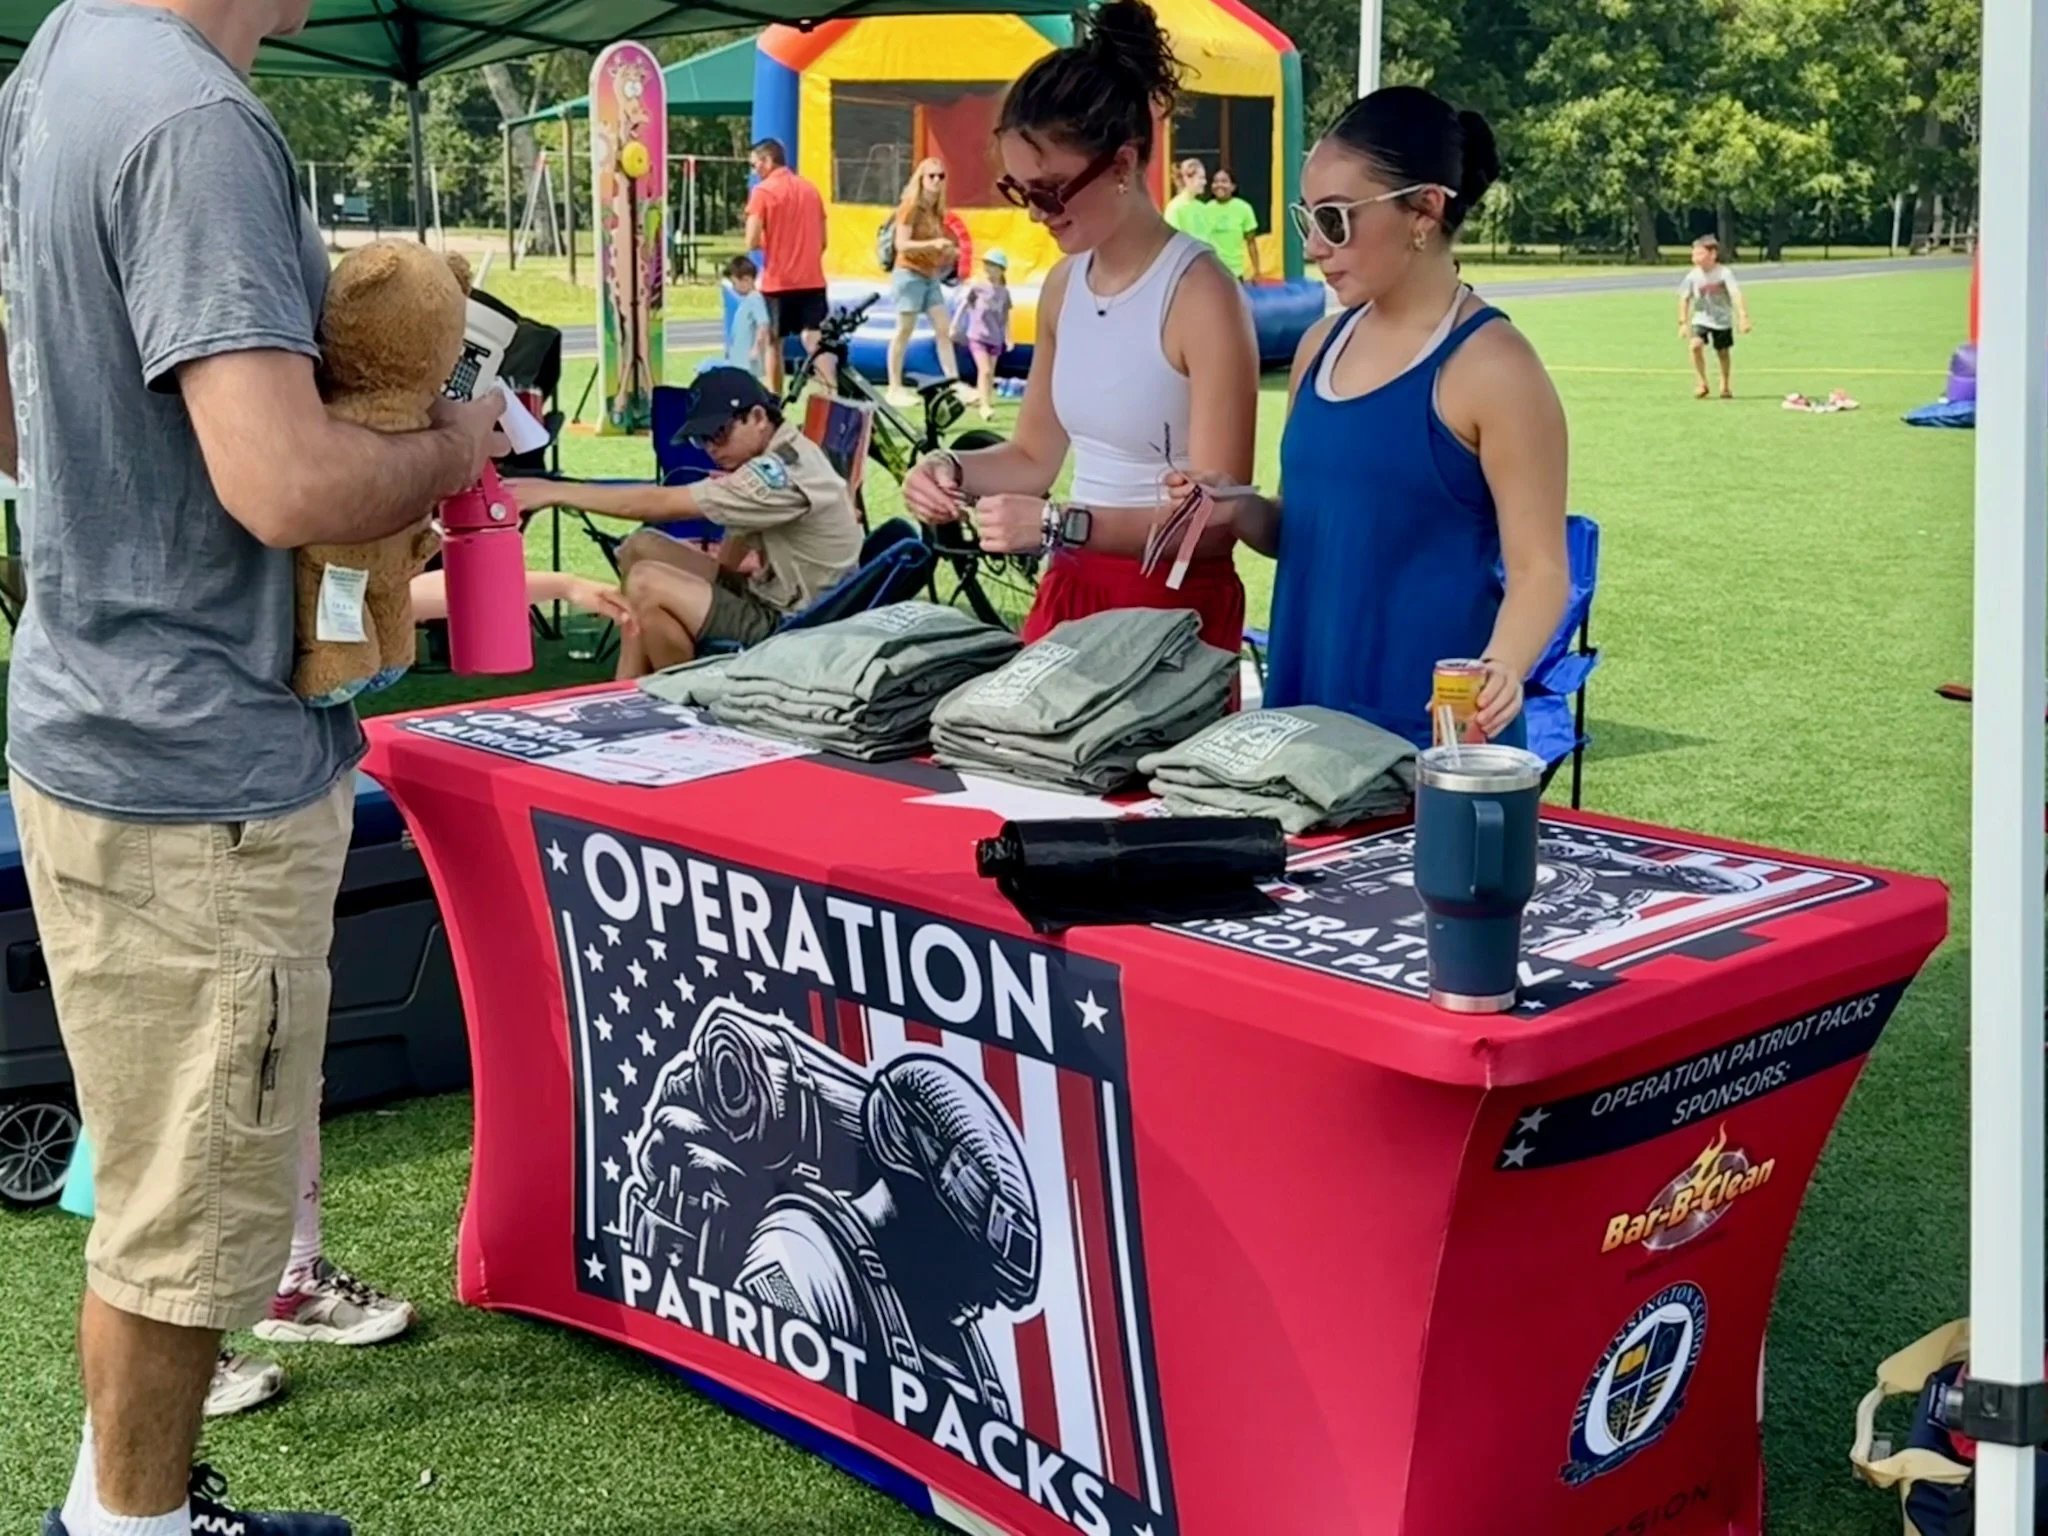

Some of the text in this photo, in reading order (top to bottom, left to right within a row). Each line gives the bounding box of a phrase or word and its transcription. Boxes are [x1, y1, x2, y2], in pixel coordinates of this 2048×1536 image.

[417, 720, 560, 756] PATRIOT
[466, 693, 604, 749] OPERA
[581, 831, 1055, 1056] OPERATION
[1330, 952, 1430, 988] PAC
[1590, 992, 1880, 1117] OPERATION PATRIOT PACKS
[1671, 1060, 1791, 1126] SPONSORS:
[1601, 1157, 1775, 1254] Bar-B-Clean
[620, 1253, 1111, 1536] PATRIOT PACKS
